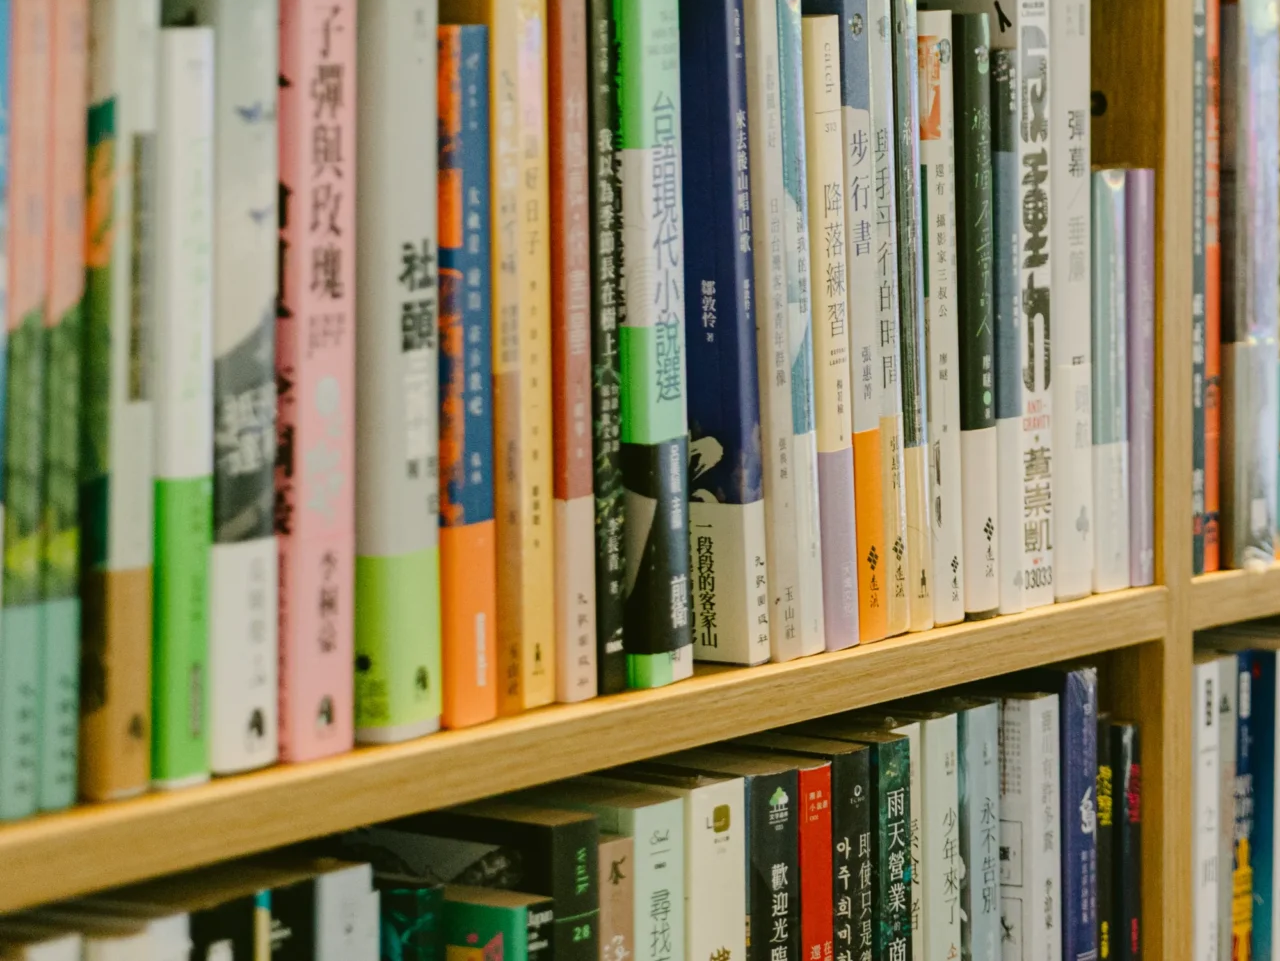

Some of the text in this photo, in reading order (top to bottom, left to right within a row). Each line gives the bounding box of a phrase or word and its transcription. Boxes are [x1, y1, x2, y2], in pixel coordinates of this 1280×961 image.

[823, 42, 836, 94] catch
[651, 90, 681, 404] 台語現代小說選
[850, 129, 873, 257] 步行書
[823, 181, 846, 338] 降落練習
[1023, 445, 1053, 553] 黃崇凱
[696, 523, 719, 649] 一段段的客家山
[784, 586, 797, 640] 玉山社
[769, 862, 789, 961] 歡迎光臨
[942, 807, 958, 925] 少年來了
[980, 796, 997, 914] 永不告別
[649, 887, 673, 961] 尋找
